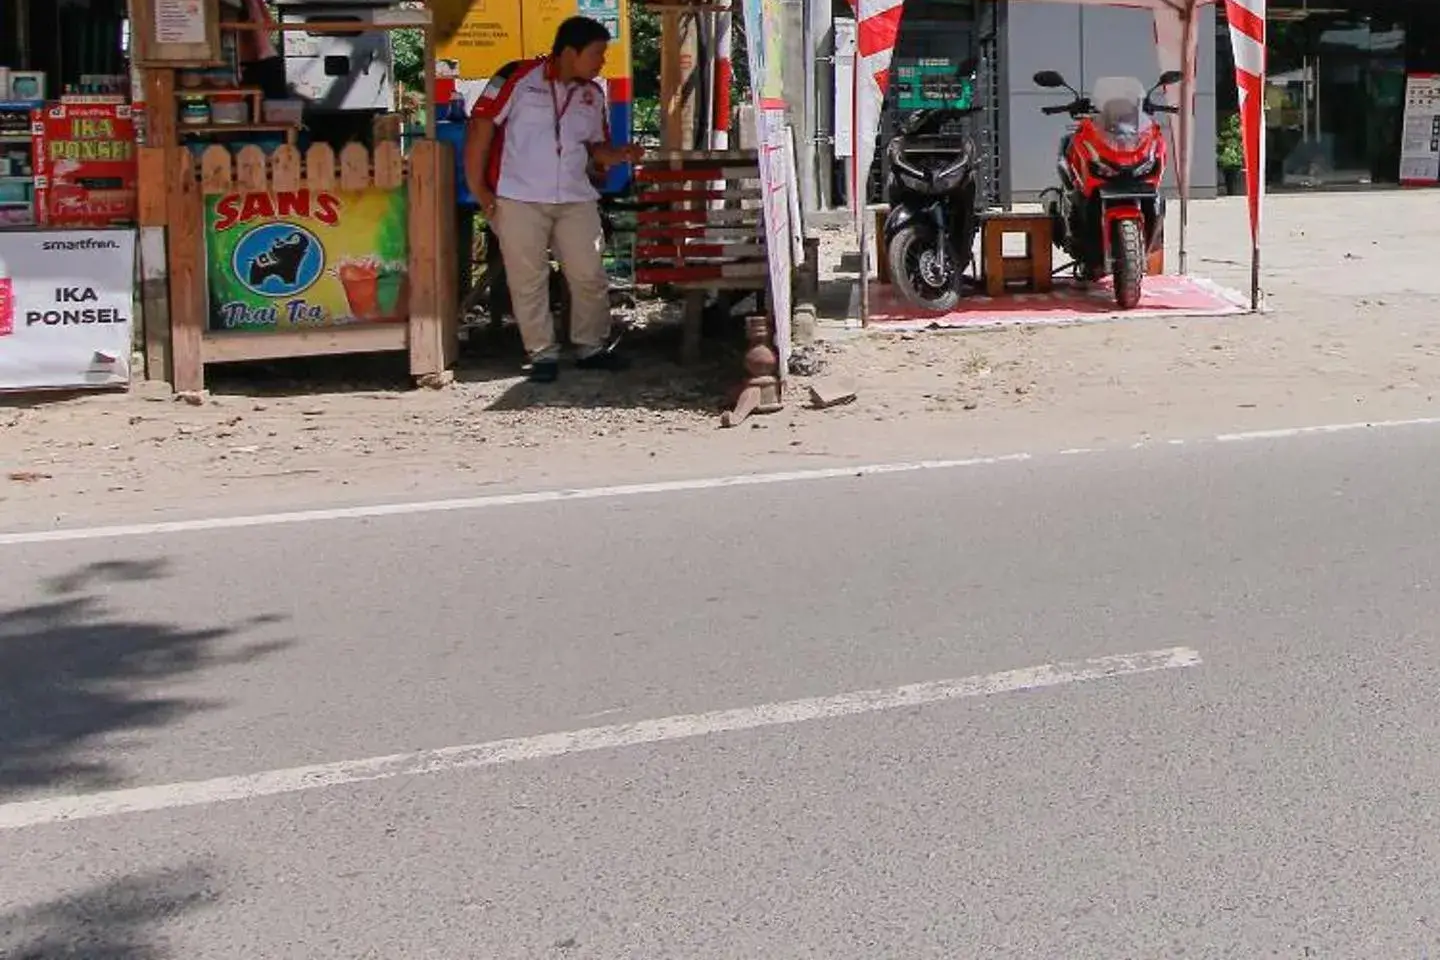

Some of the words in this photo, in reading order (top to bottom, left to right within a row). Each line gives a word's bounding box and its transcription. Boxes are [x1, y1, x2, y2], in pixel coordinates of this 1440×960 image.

[214, 188, 341, 231] SANS
[54, 287, 99, 303] IKA
[26, 308, 127, 327] PONSEL
